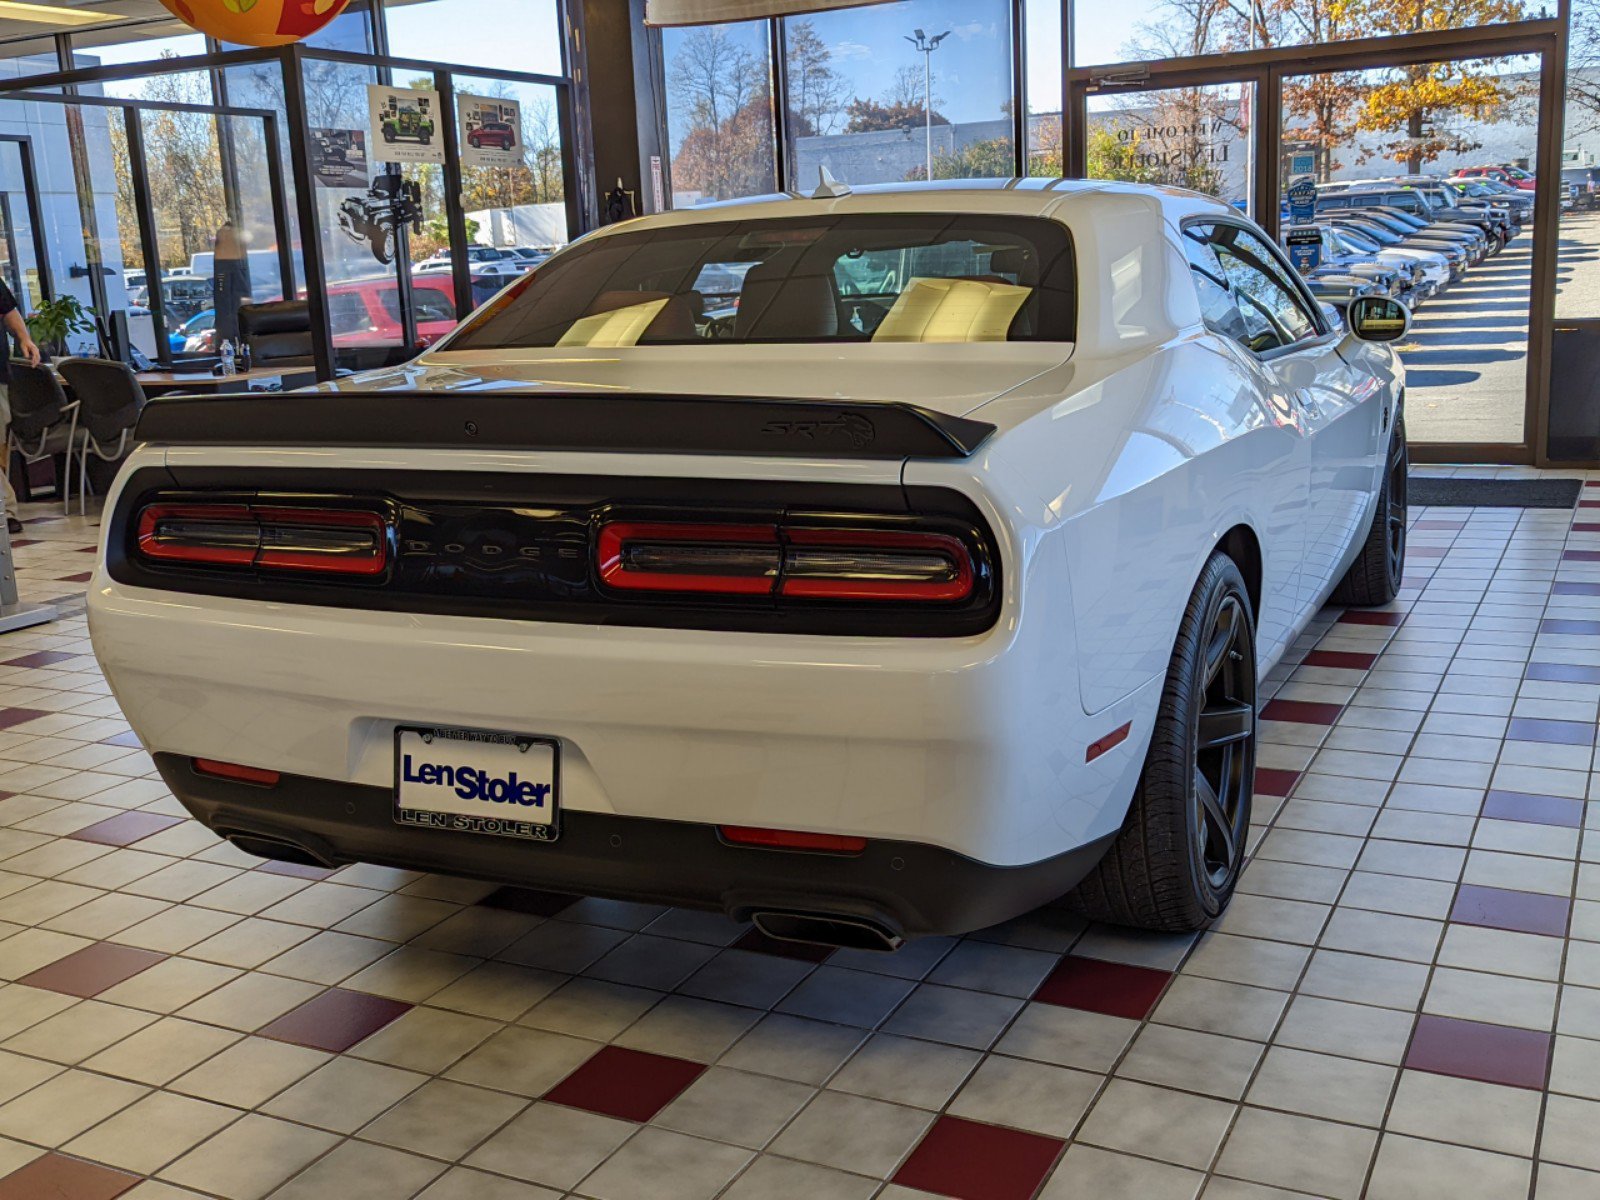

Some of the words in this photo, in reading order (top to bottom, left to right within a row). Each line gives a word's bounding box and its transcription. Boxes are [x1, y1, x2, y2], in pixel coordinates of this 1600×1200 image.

[761, 420, 844, 440] SRT
[405, 539, 580, 559] DODGE
[400, 809, 447, 827] LEN
[453, 815, 548, 840] STOLER
